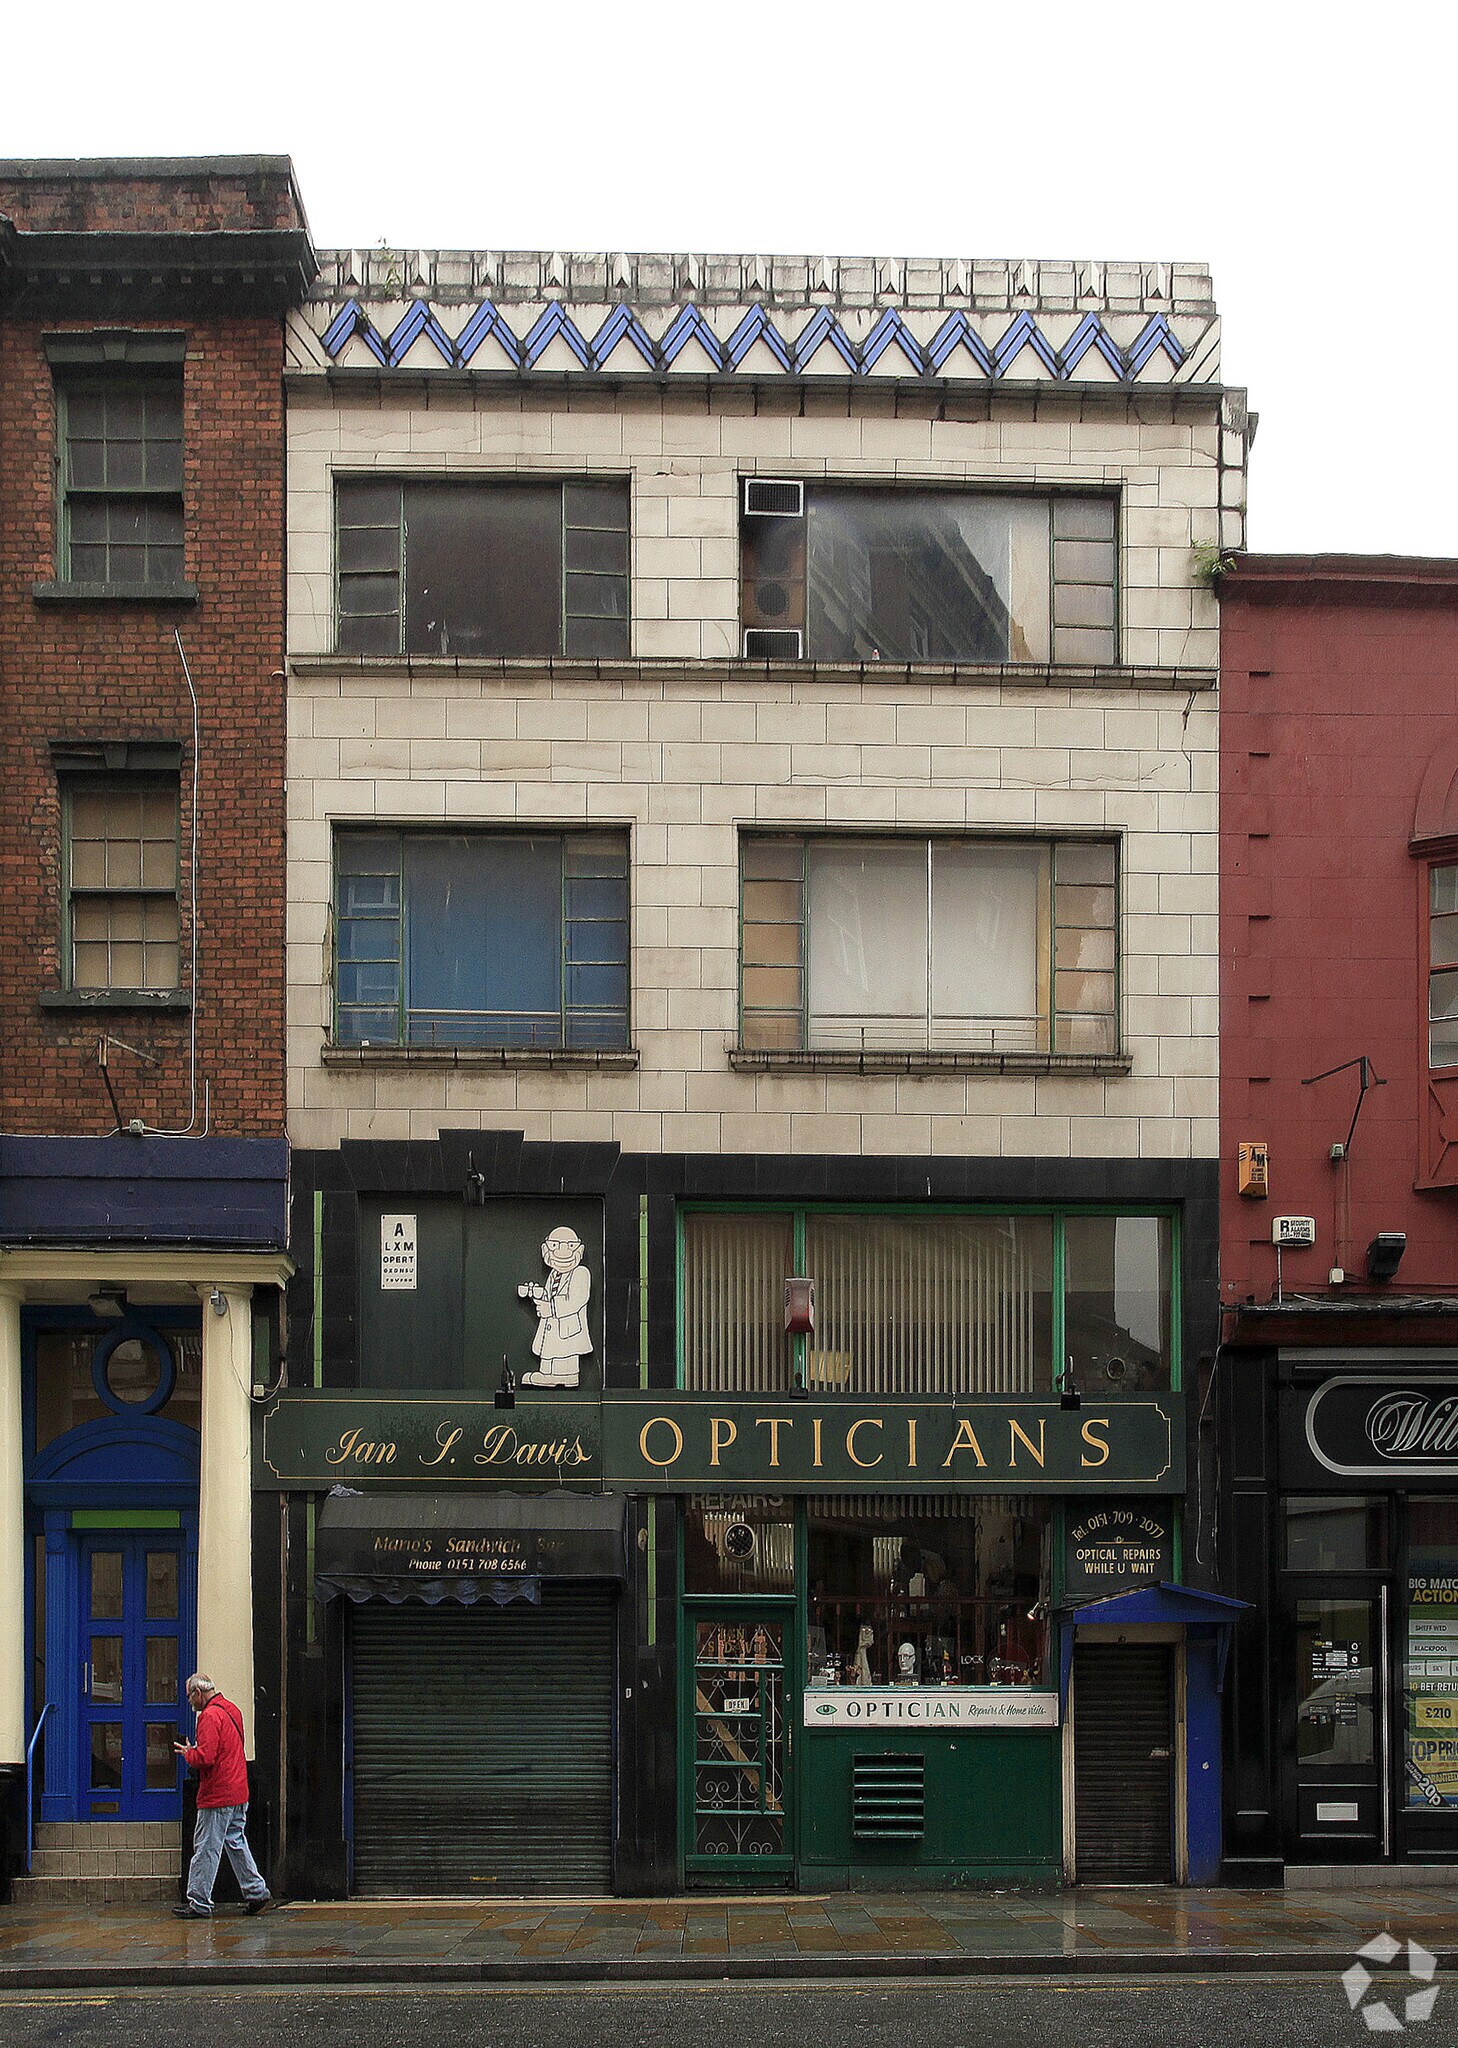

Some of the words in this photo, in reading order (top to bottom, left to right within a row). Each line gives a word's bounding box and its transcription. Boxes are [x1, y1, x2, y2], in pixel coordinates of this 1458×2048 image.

[394, 1223, 404, 1237] A
[1280, 1220, 1289, 1231] R
[325, 1427, 398, 1465] Ian
[473, 1425, 593, 1466] Davis
[639, 1417, 1110, 1467] OPTICIANS
[690, 1494, 784, 1510] REPAIRS
[446, 1536, 521, 1554] Sandwich
[1076, 1549, 1117, 1560] OPTICAL
[1123, 1549, 1161, 1560] REPAIRS
[408, 1558, 442, 1571] Phone
[447, 1558, 475, 1571] 0151
[478, 1558, 499, 1570] 708
[1084, 1563, 1114, 1574] WHILE
[1117, 1563, 1126, 1574] U
[1131, 1563, 1155, 1574] WAIT
[1408, 1578, 1427, 1589] BIG
[1420, 1682, 1435, 1691] BET
[728, 1700, 745, 1709] OPEN
[846, 1702, 960, 1718] OPTICIAN
[968, 1704, 997, 1717] Repairs
[999, 1704, 1007, 1715] &
[1006, 1704, 1027, 1715] Home
[1426, 1707, 1451, 1719] £210
[1416, 1777, 1442, 1806] 20p
